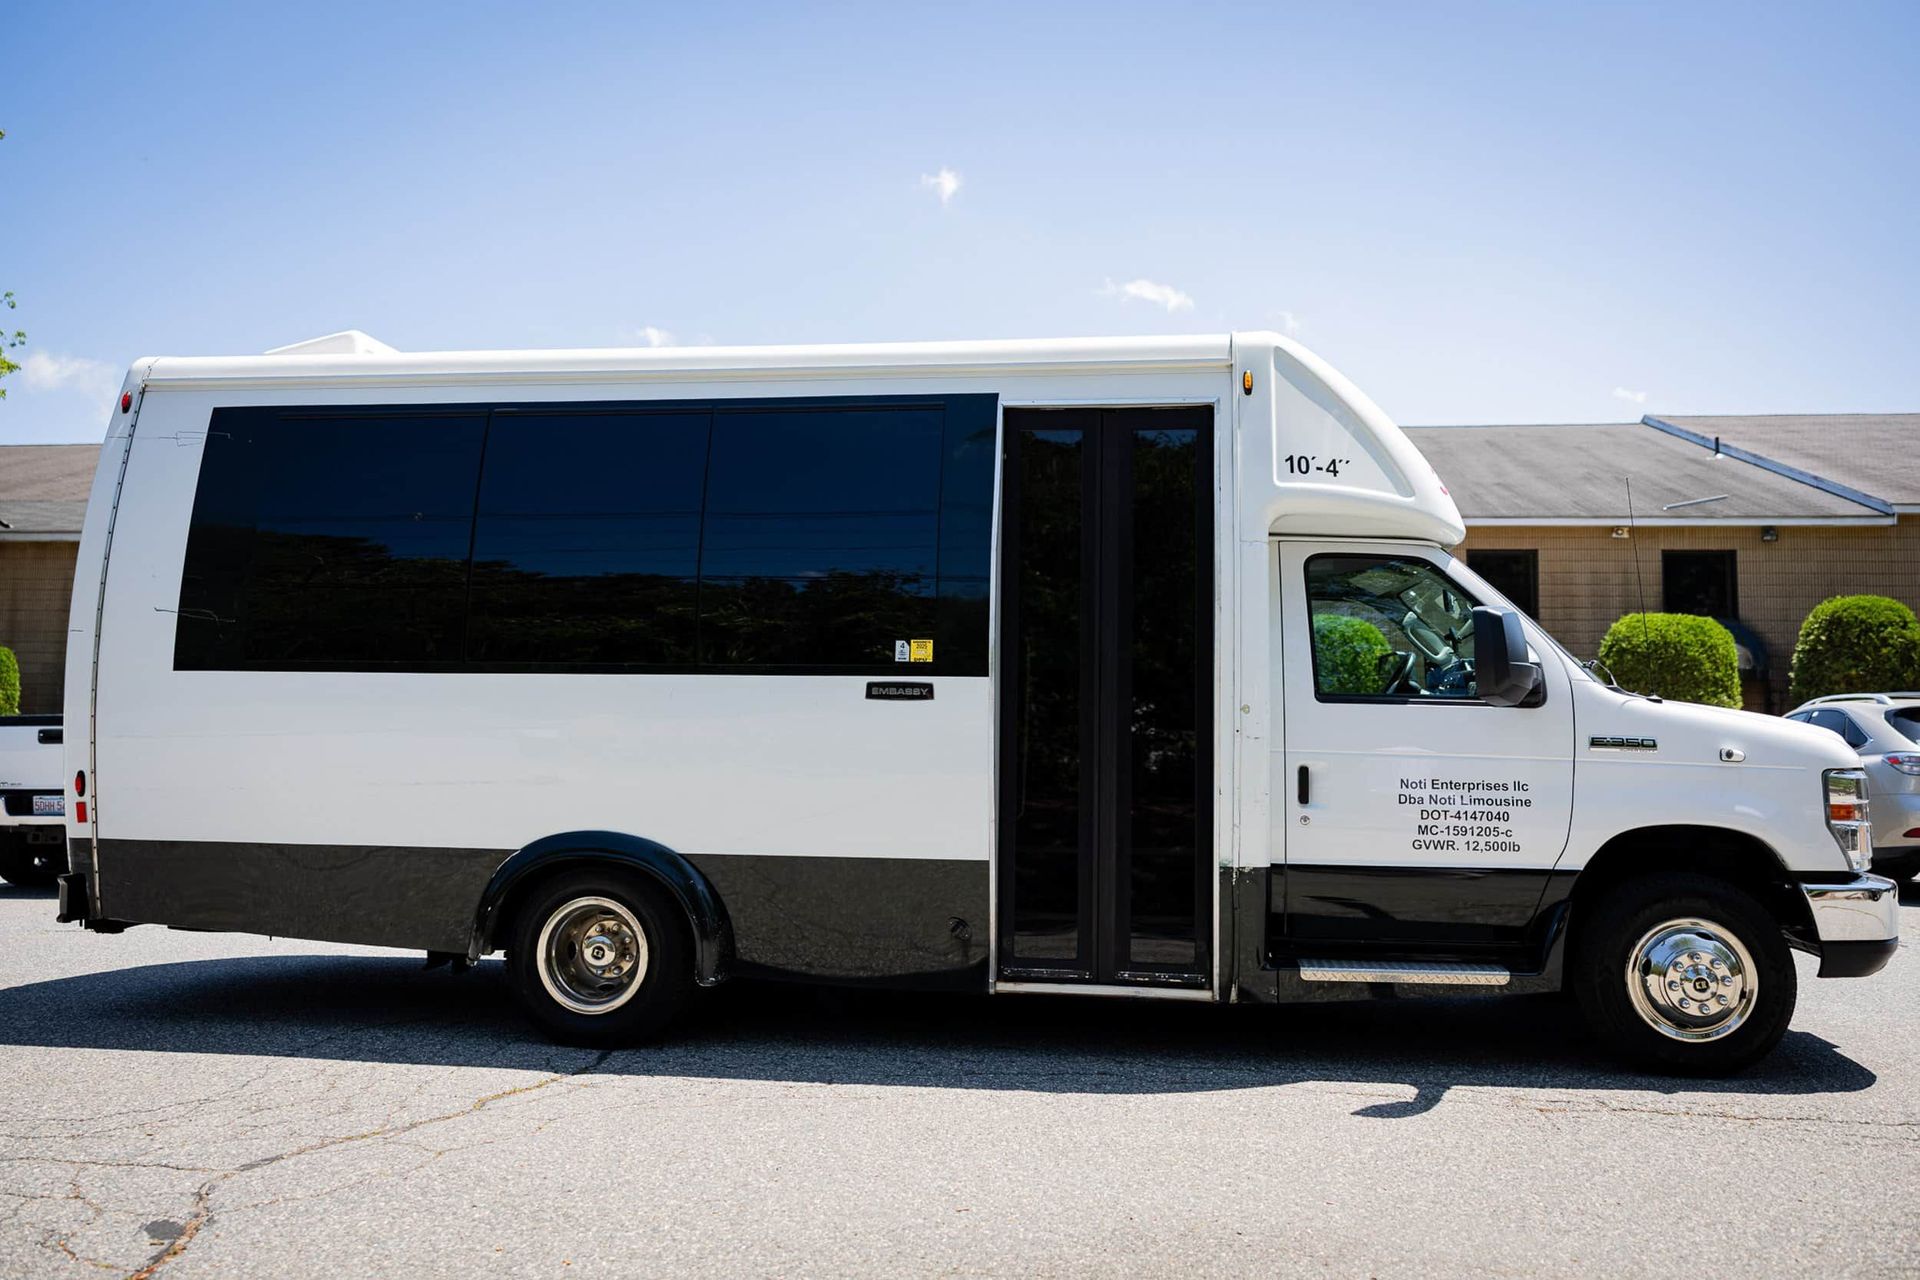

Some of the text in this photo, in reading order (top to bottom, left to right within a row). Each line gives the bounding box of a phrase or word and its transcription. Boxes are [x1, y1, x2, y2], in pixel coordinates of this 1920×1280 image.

[871, 687, 929, 696] EMBASSY
[1590, 736, 1657, 748] E-350
[1400, 778, 1427, 790] Noti
[1431, 778, 1509, 793] Enterprises
[1398, 793, 1532, 807] Dba Noti Limousine
[1420, 809, 1510, 822] DOT-4147040
[1417, 825, 1513, 837] MC-1591205-c
[1412, 839, 1521, 853] GVWR. 12,500lb
